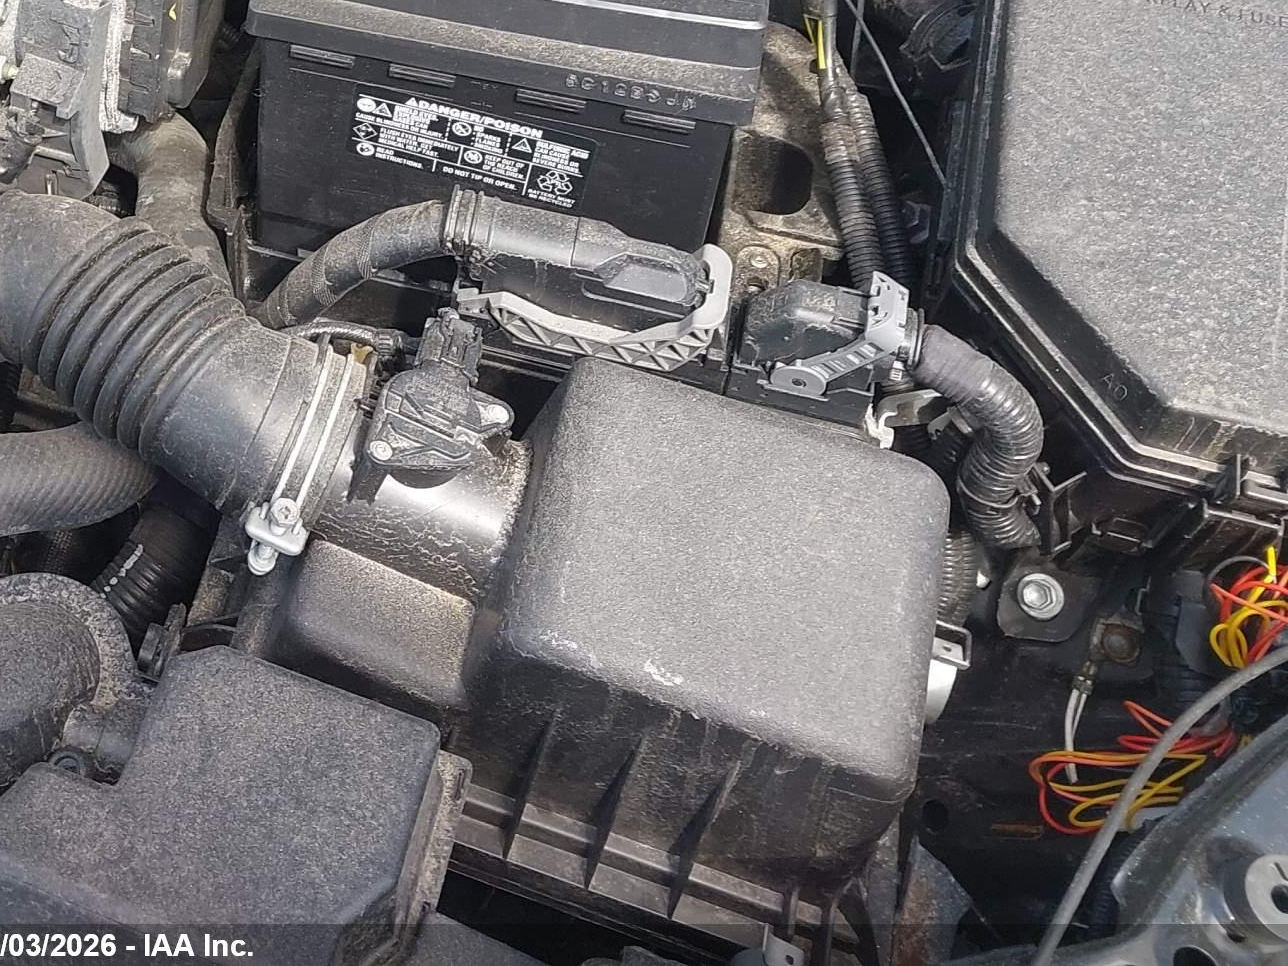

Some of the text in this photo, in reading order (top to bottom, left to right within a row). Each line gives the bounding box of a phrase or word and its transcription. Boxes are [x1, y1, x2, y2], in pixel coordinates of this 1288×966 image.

[355, 112, 375, 121] CAUSE
[376, 117, 409, 129] BLINDNESS
[418, 100, 543, 139] DANGER/POISON
[379, 132, 394, 140] WITH
[380, 127, 458, 151] FLUSH EYES IMMEDIATELY
[376, 146, 394, 155] READ
[377, 137, 439, 157] MEDICAL HELP FAST.
[535, 146, 569, 159] CAN CAUSE
[484, 154, 501, 162] KEEP
[501, 158, 514, 166] OUT
[532, 157, 556, 167] SEVERE
[533, 152, 568, 165] BLINDNESS
[496, 162, 518, 172] REACH
[442, 165, 517, 190] DO NOT TIP OR OPEN.
[527, 188, 575, 204] BATTERY MUST
[538, 195, 572, 208] RECYCLED
